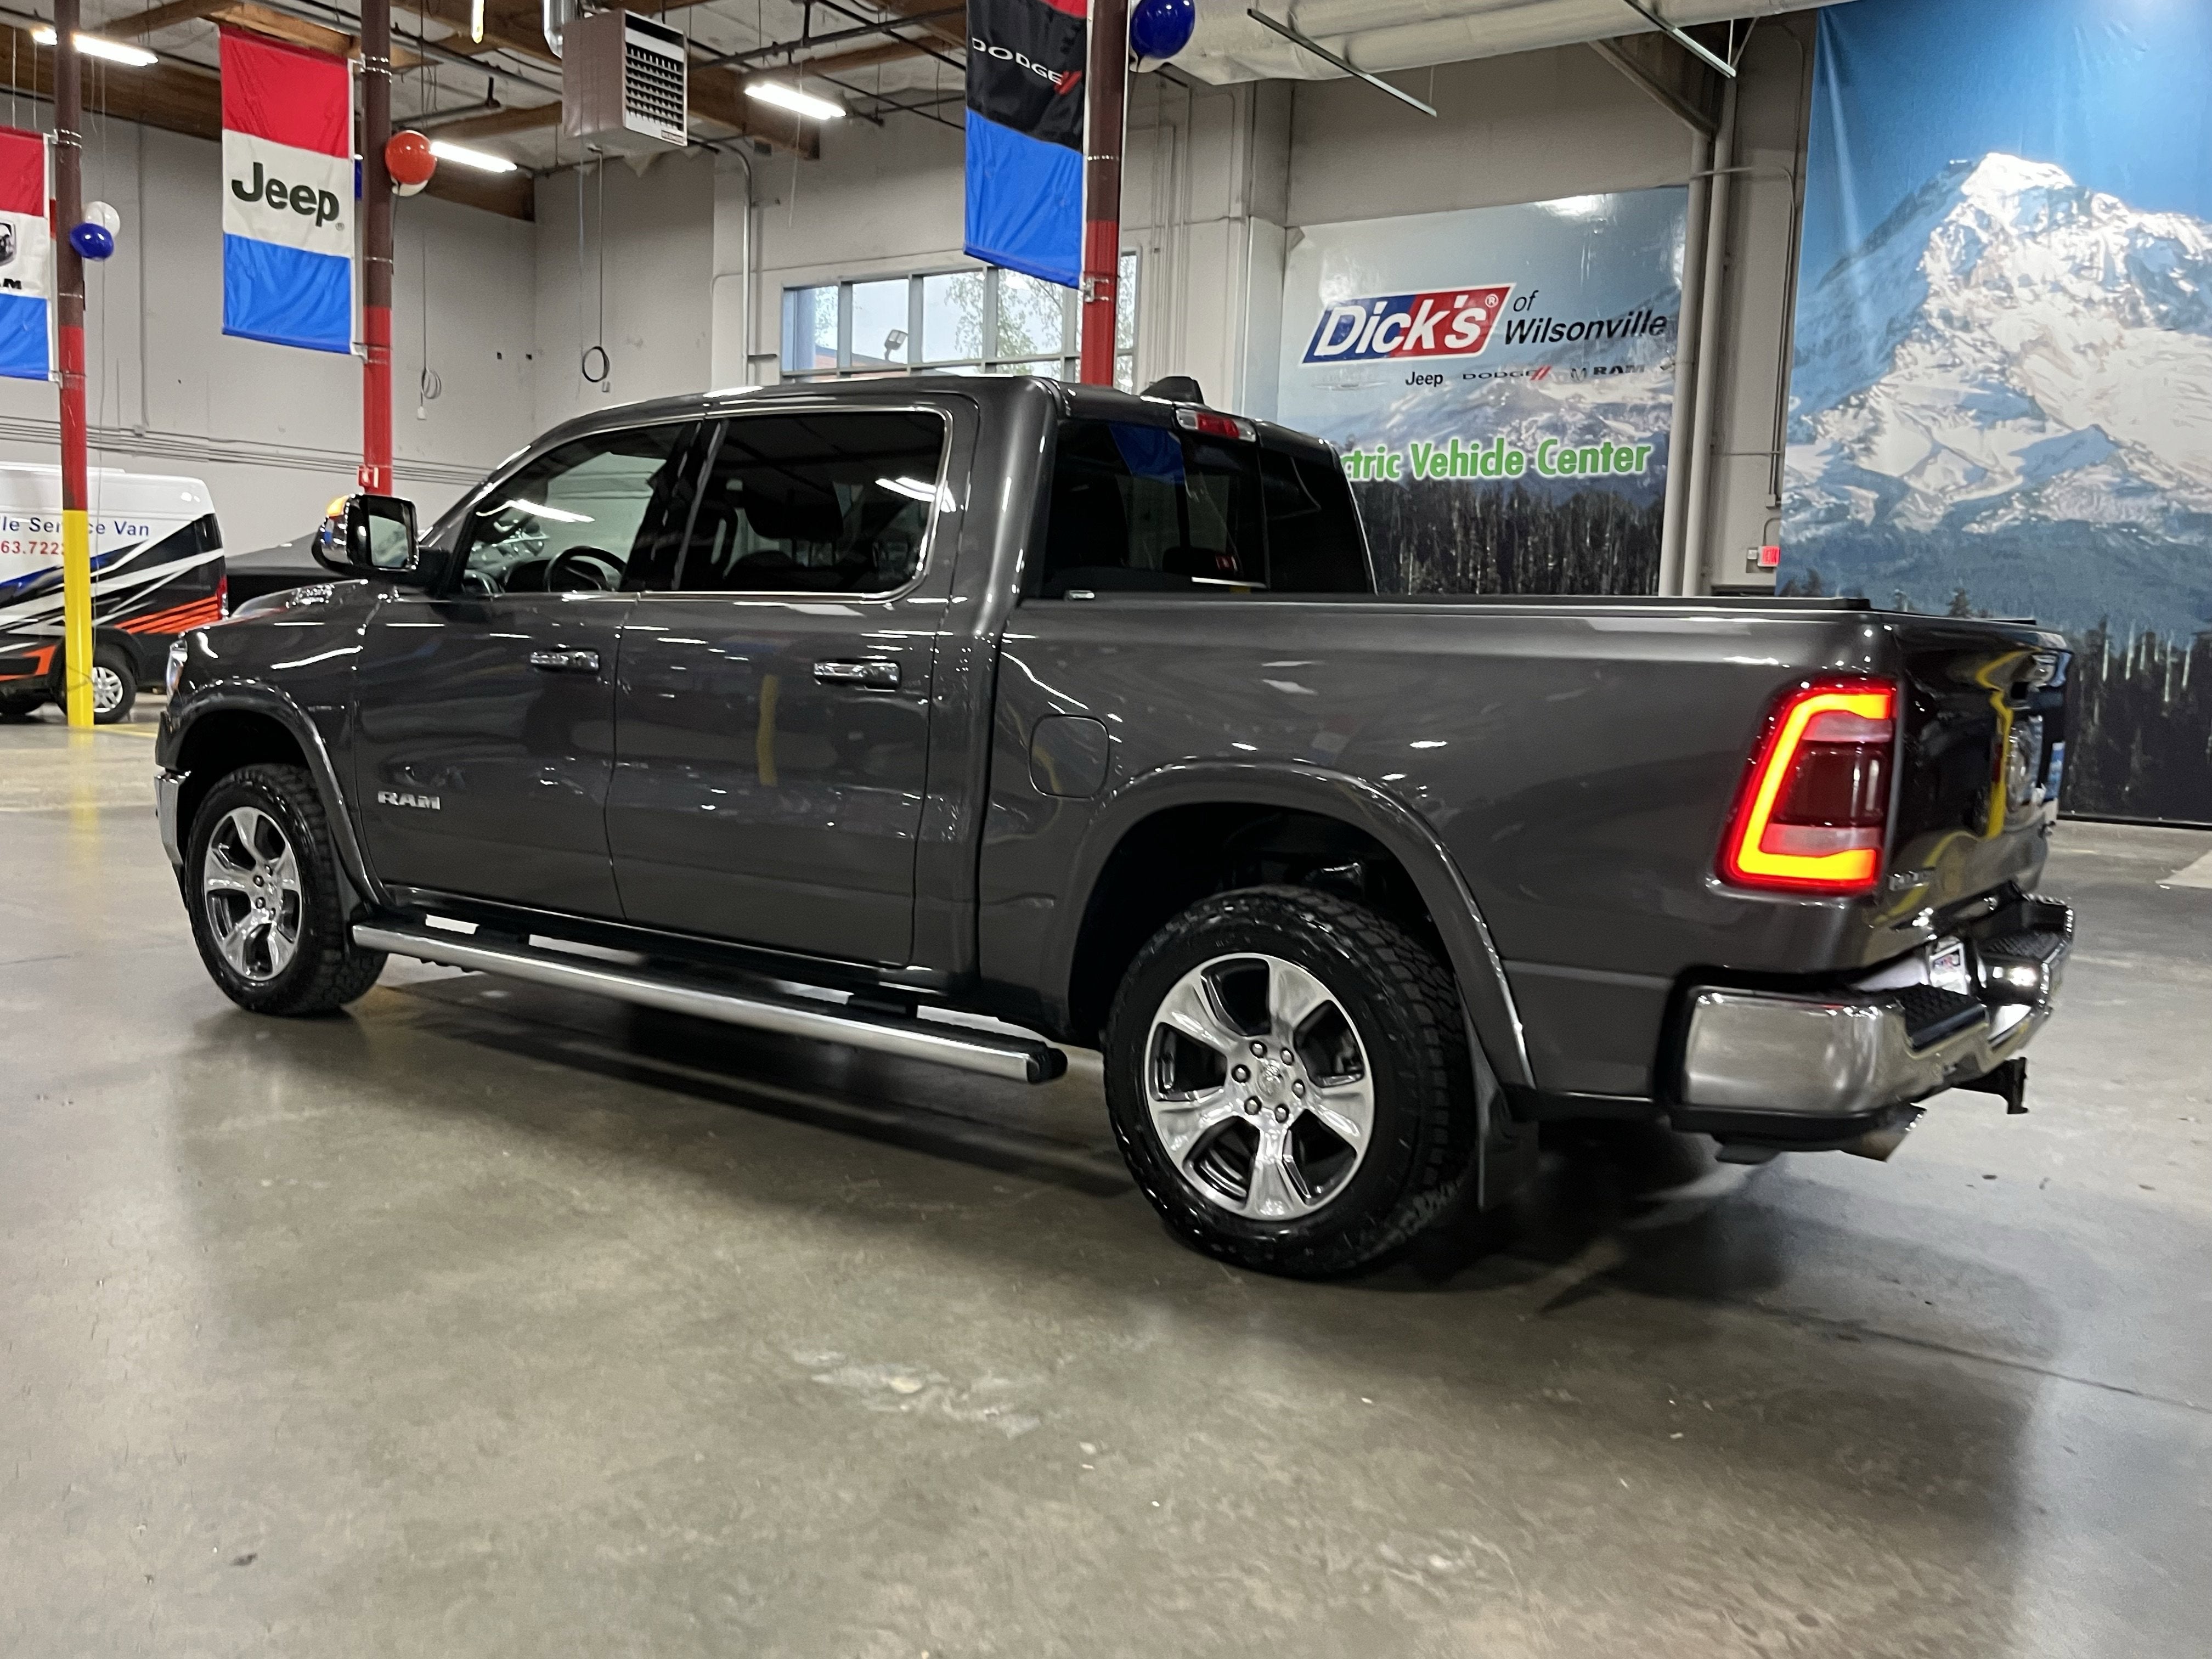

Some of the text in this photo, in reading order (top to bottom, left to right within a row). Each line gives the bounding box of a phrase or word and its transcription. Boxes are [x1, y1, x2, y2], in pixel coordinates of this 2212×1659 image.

[972, 37, 1063, 86] DODGE
[232, 162, 340, 227] Jeep
[1513, 290, 1538, 312] of
[1505, 310, 1668, 345] Wilsonville
[1406, 371, 1443, 387] Jeep
[1593, 364, 1645, 375] RAM
[1410, 438, 1524, 477] Vehicle
[1538, 439, 1651, 475] Center
[114, 521, 150, 537] Van
[378, 791, 441, 810] RAM
